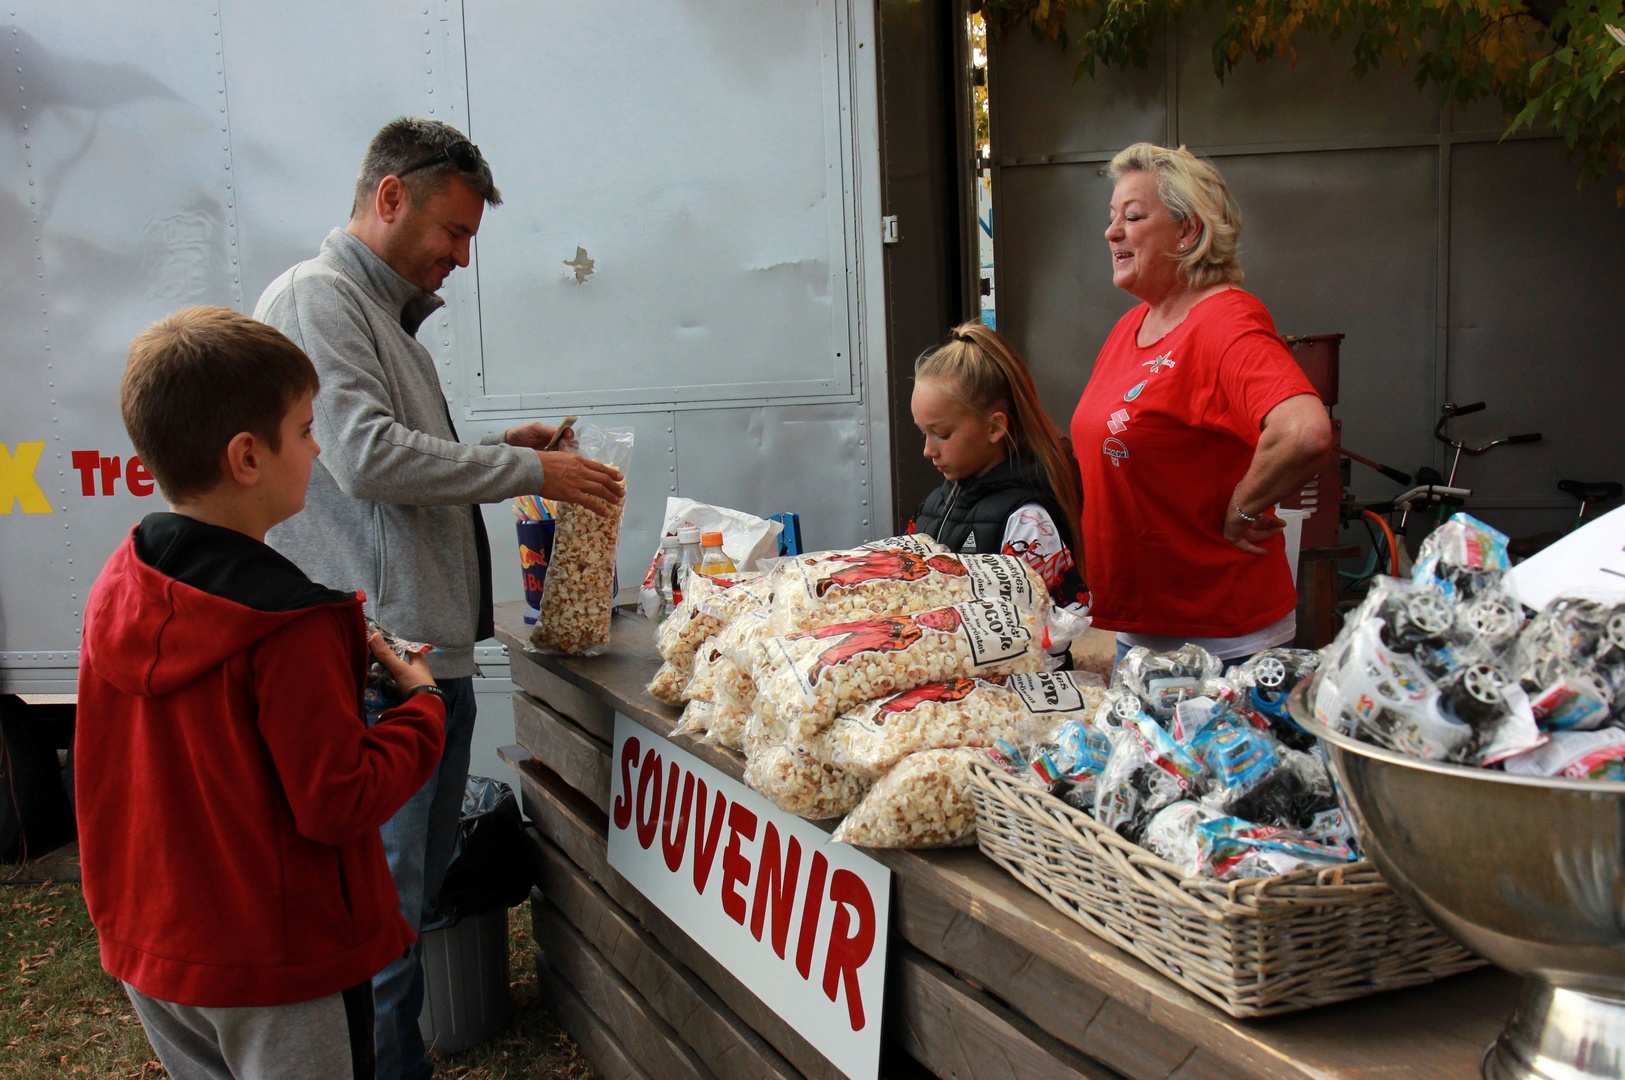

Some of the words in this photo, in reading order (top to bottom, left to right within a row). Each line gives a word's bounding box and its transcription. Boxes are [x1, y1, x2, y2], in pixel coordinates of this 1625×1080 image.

[981, 554, 1012, 604] opcorn
[1036, 672, 1059, 705] orn
[613, 736, 876, 1032] SOUVENIR
